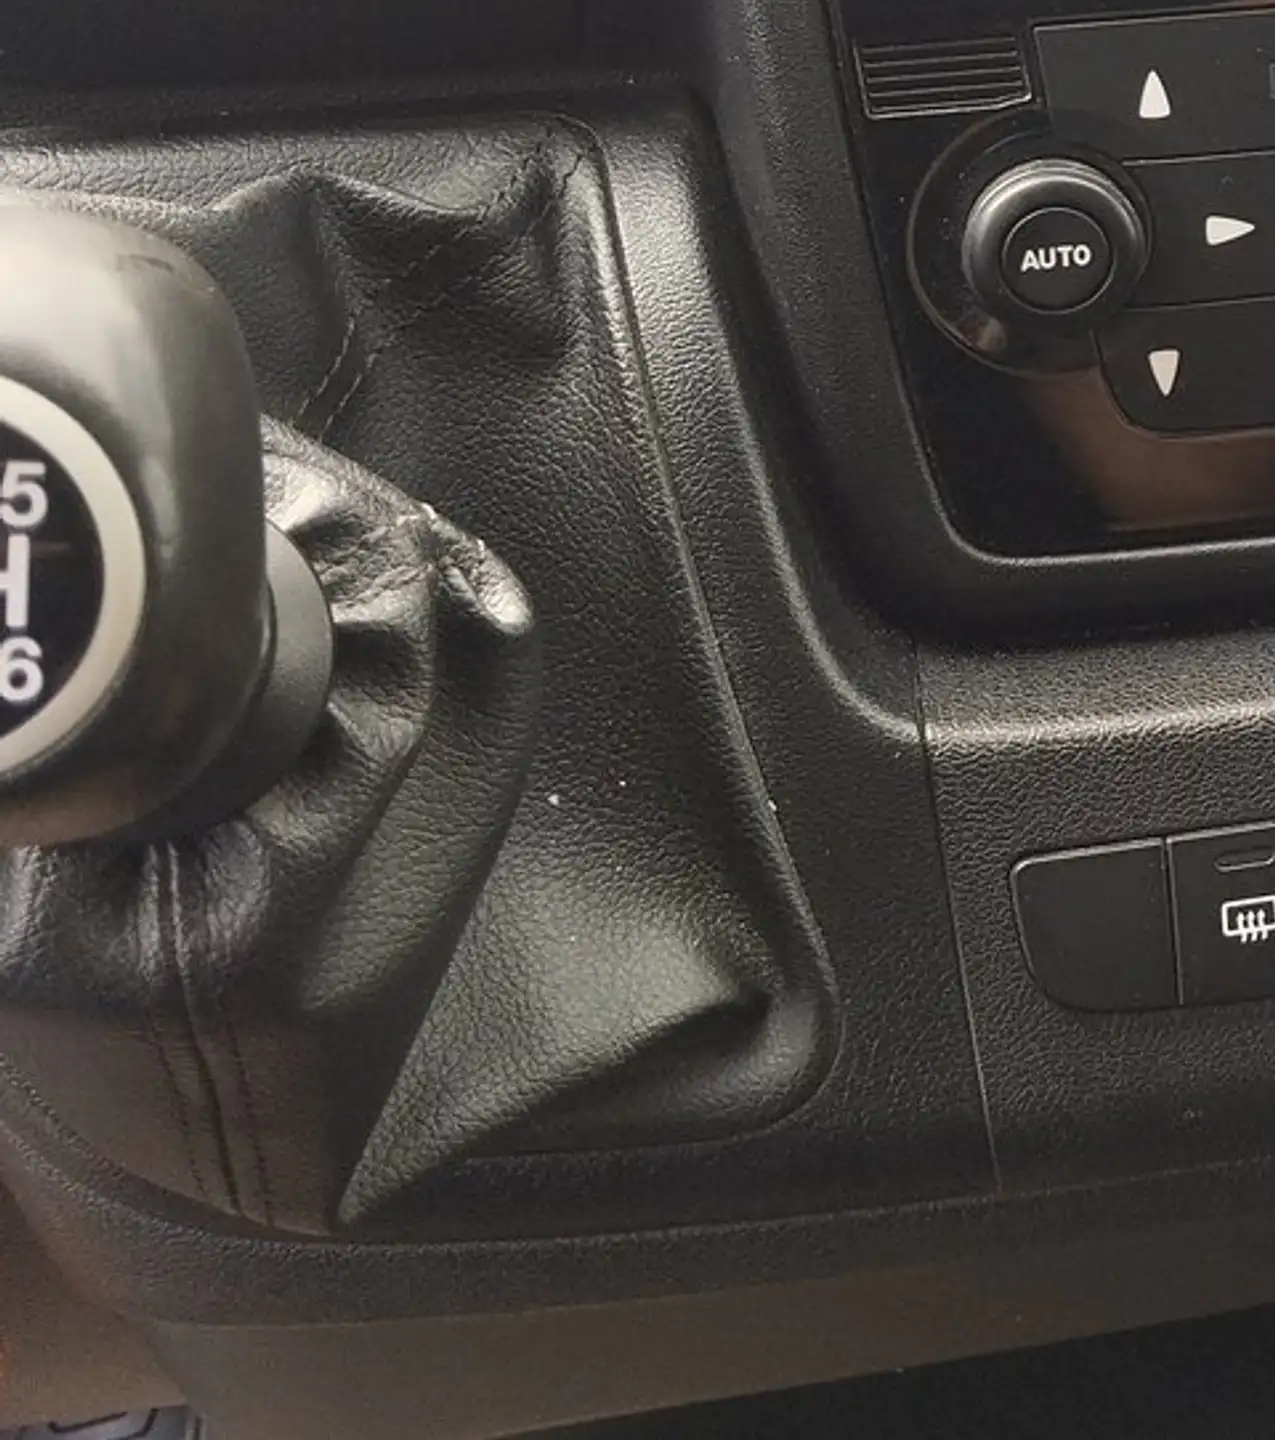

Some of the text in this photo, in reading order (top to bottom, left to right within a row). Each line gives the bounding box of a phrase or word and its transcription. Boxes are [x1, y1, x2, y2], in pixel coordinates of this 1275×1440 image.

[1020, 243, 1092, 273] AUTO
[0, 459, 49, 530] 5
[0, 634, 44, 702] 6
